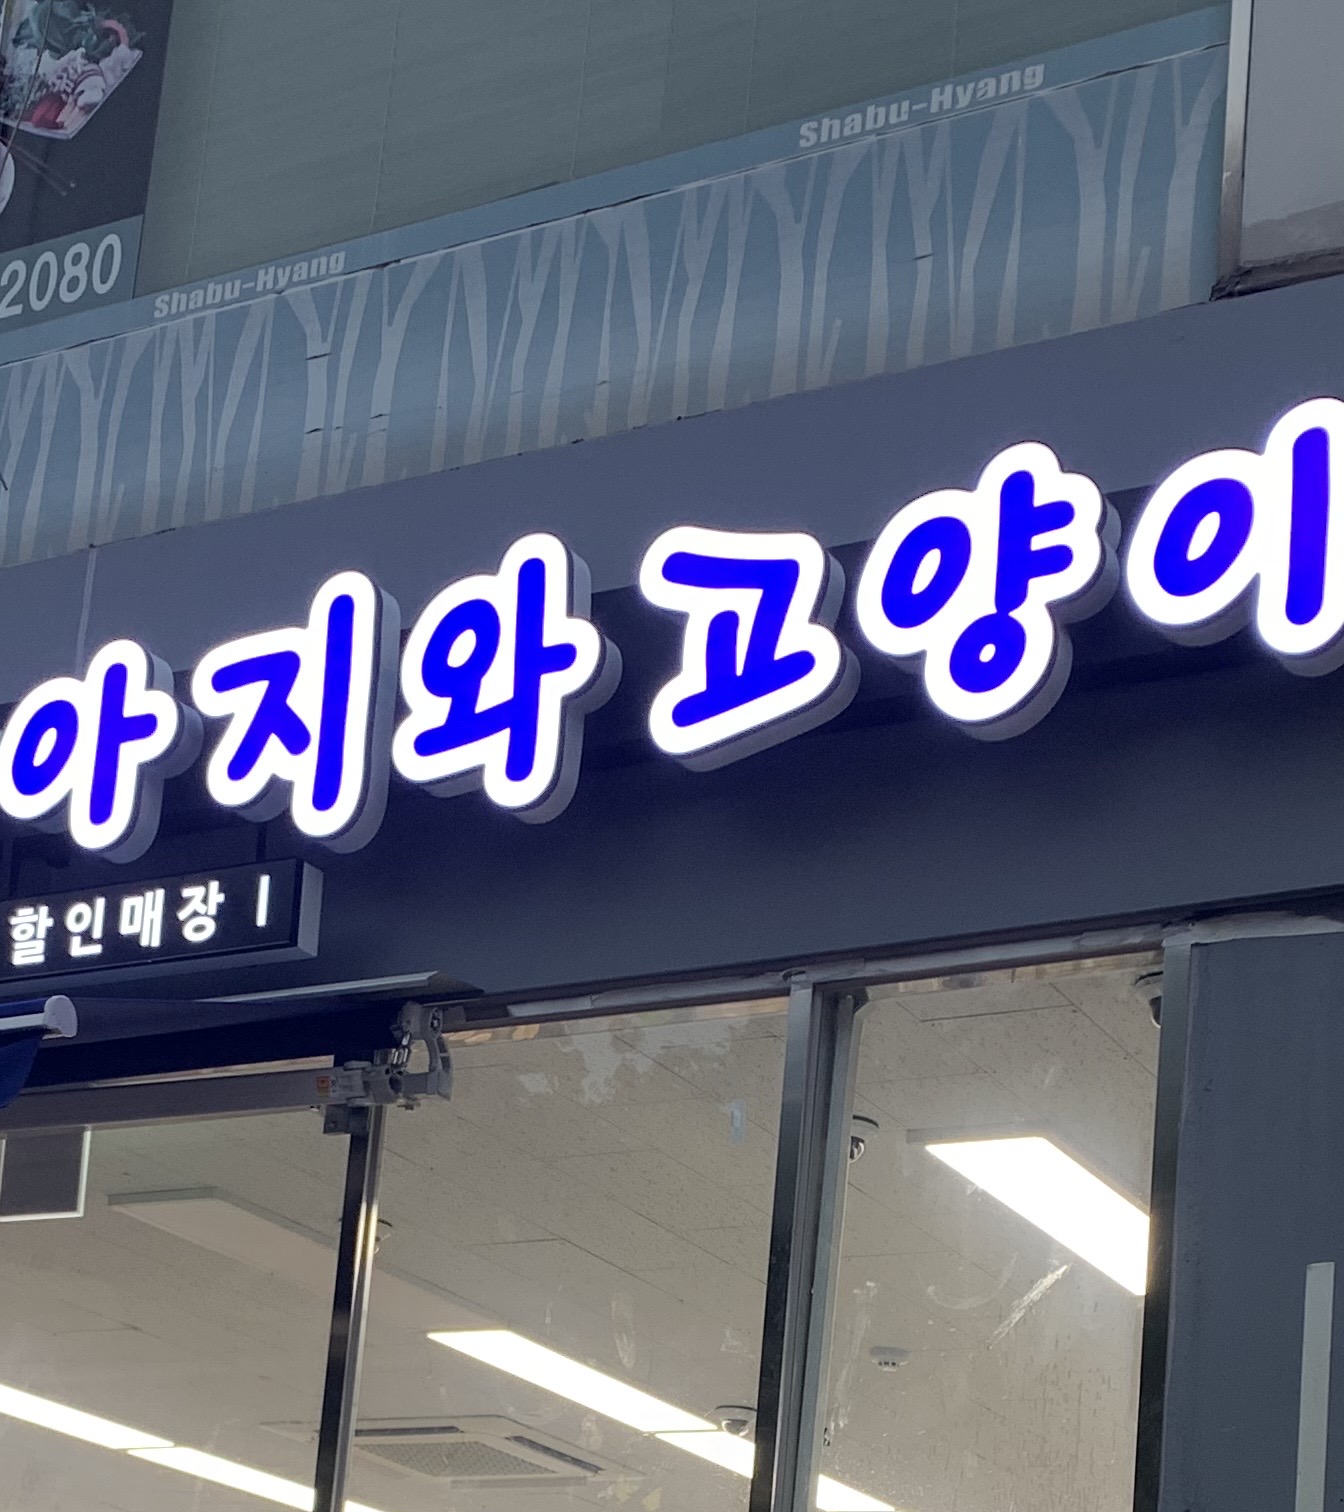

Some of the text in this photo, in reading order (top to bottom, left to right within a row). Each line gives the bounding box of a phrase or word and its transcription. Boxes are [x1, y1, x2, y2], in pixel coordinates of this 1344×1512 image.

[798, 63, 1046, 149] Shabu-Hyang
[152, 248, 347, 320] Shabu-Hyang
[8, 880, 226, 967] 할인매장
